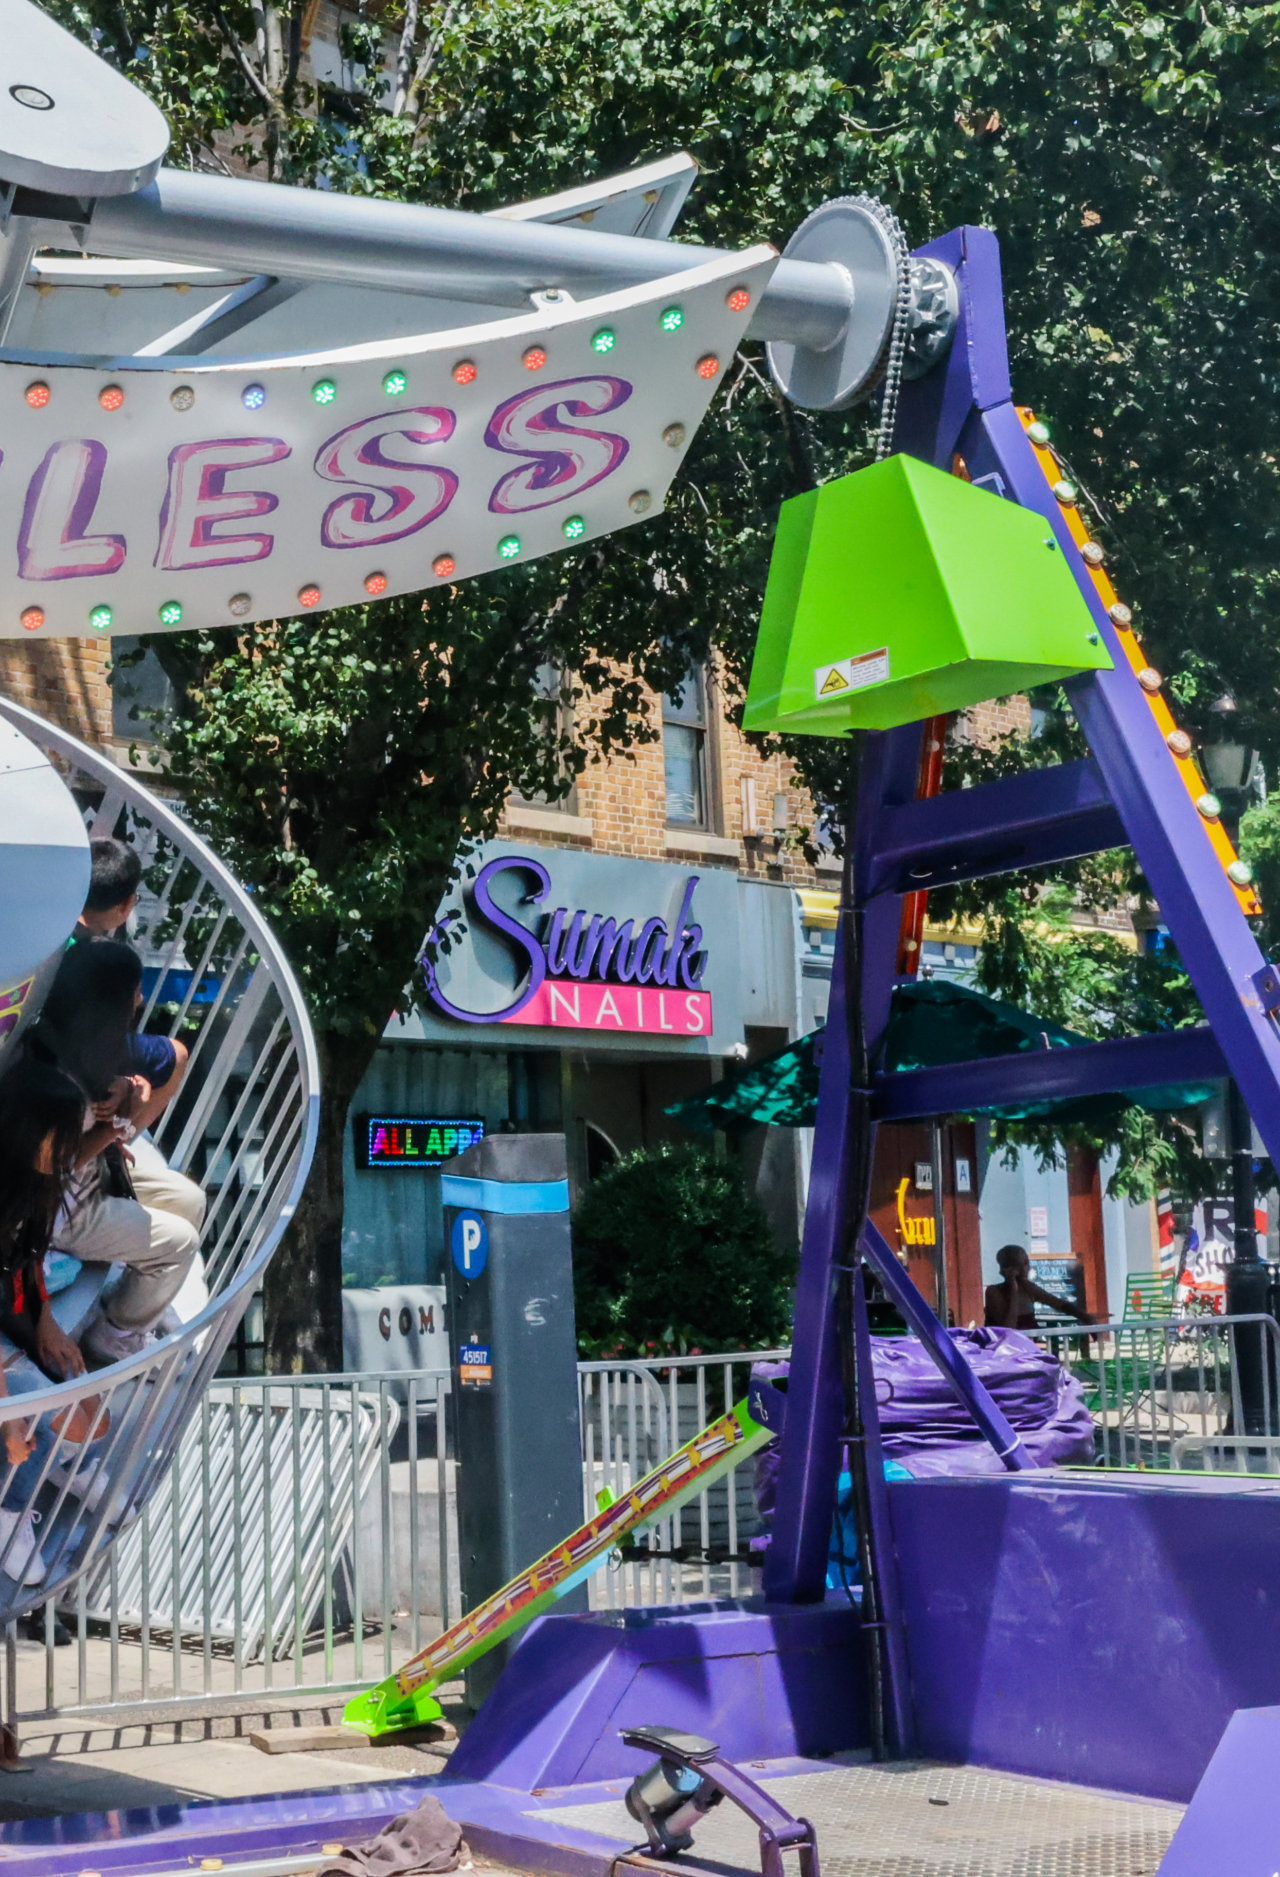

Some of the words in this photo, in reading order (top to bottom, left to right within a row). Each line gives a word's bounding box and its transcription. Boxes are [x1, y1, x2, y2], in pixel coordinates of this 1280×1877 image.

[420, 856, 709, 1024] Sumak
[549, 983, 704, 1032] NAILS
[372, 1128, 419, 1154] ALL
[379, 1305, 449, 1342] COM
